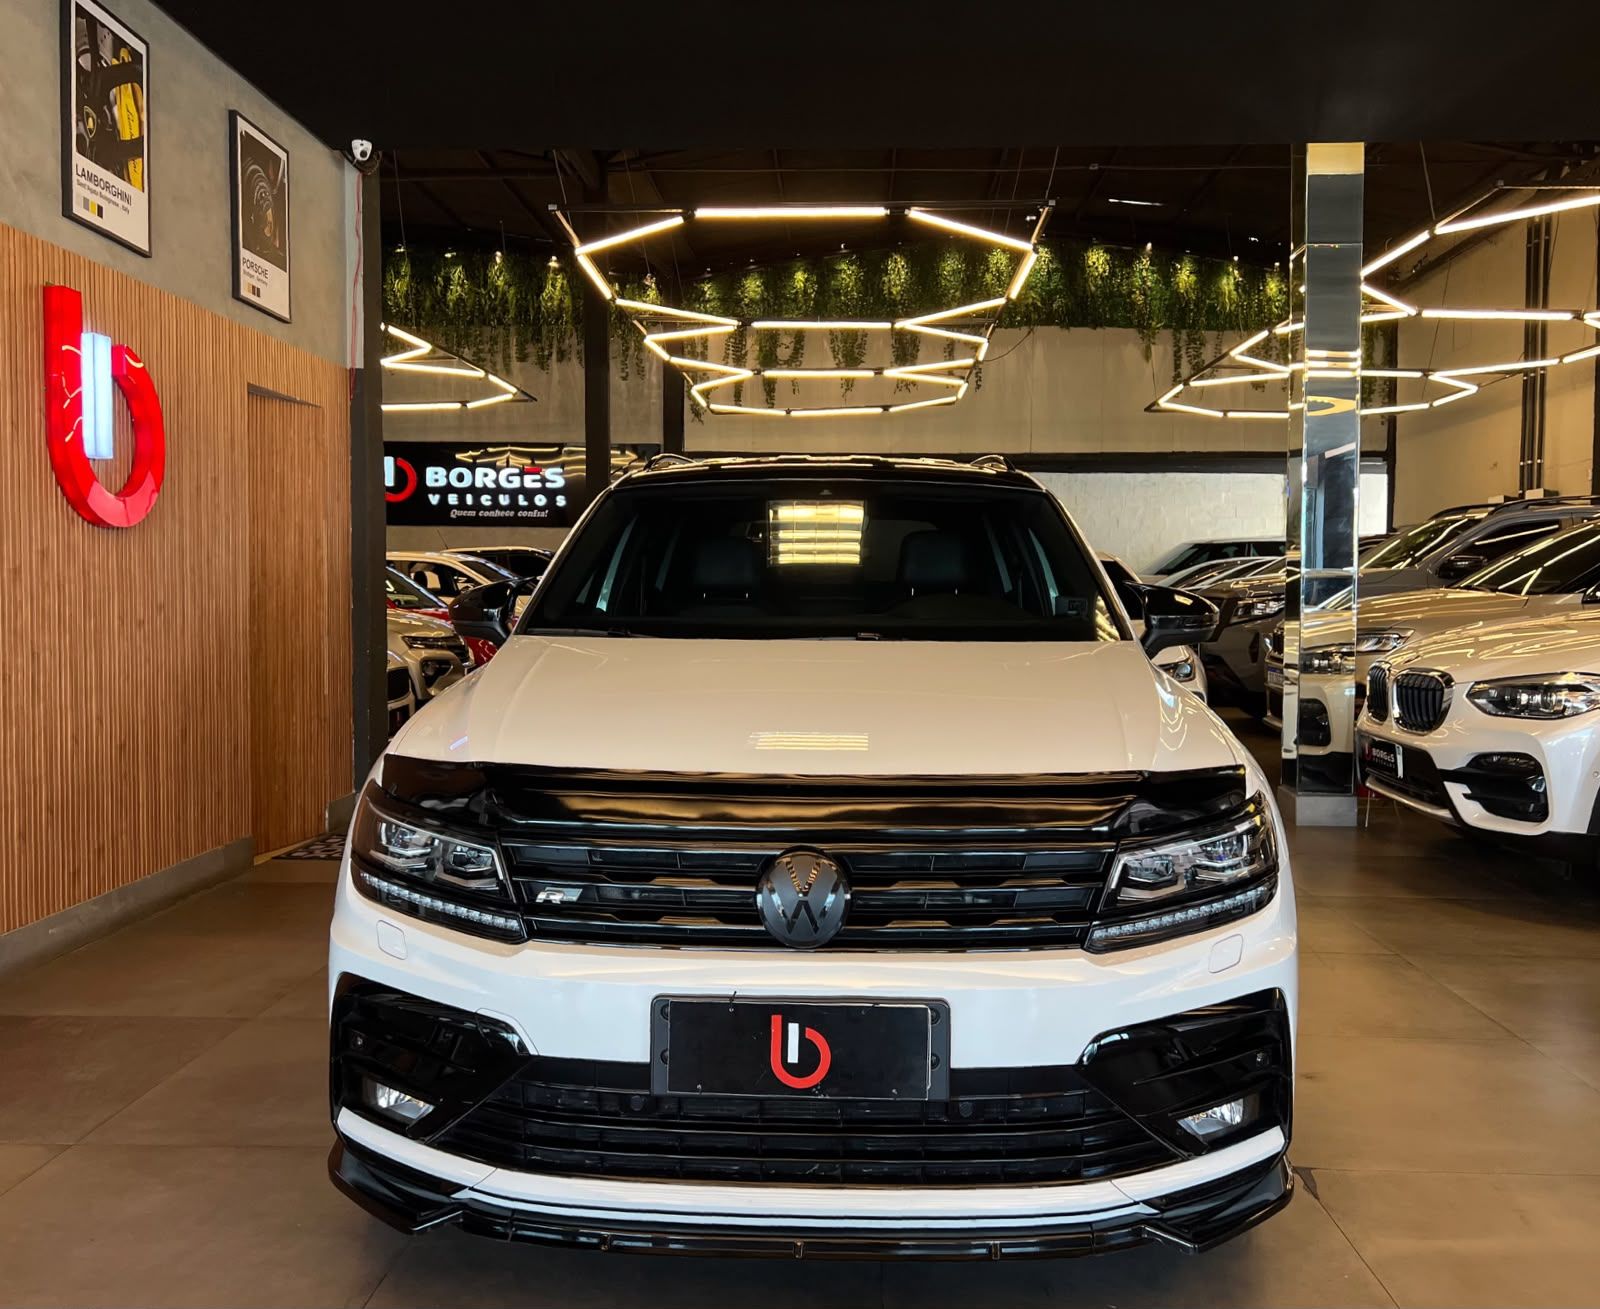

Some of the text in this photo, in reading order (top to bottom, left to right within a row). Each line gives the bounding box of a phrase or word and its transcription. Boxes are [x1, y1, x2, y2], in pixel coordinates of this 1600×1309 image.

[75, 163, 132, 206] LAMBORGHINI
[242, 257, 269, 279] PORSCHE
[425, 466, 566, 489] BORGES
[428, 494, 567, 507] VEICULOS
[450, 509, 549, 518] Quem conhece confia!
